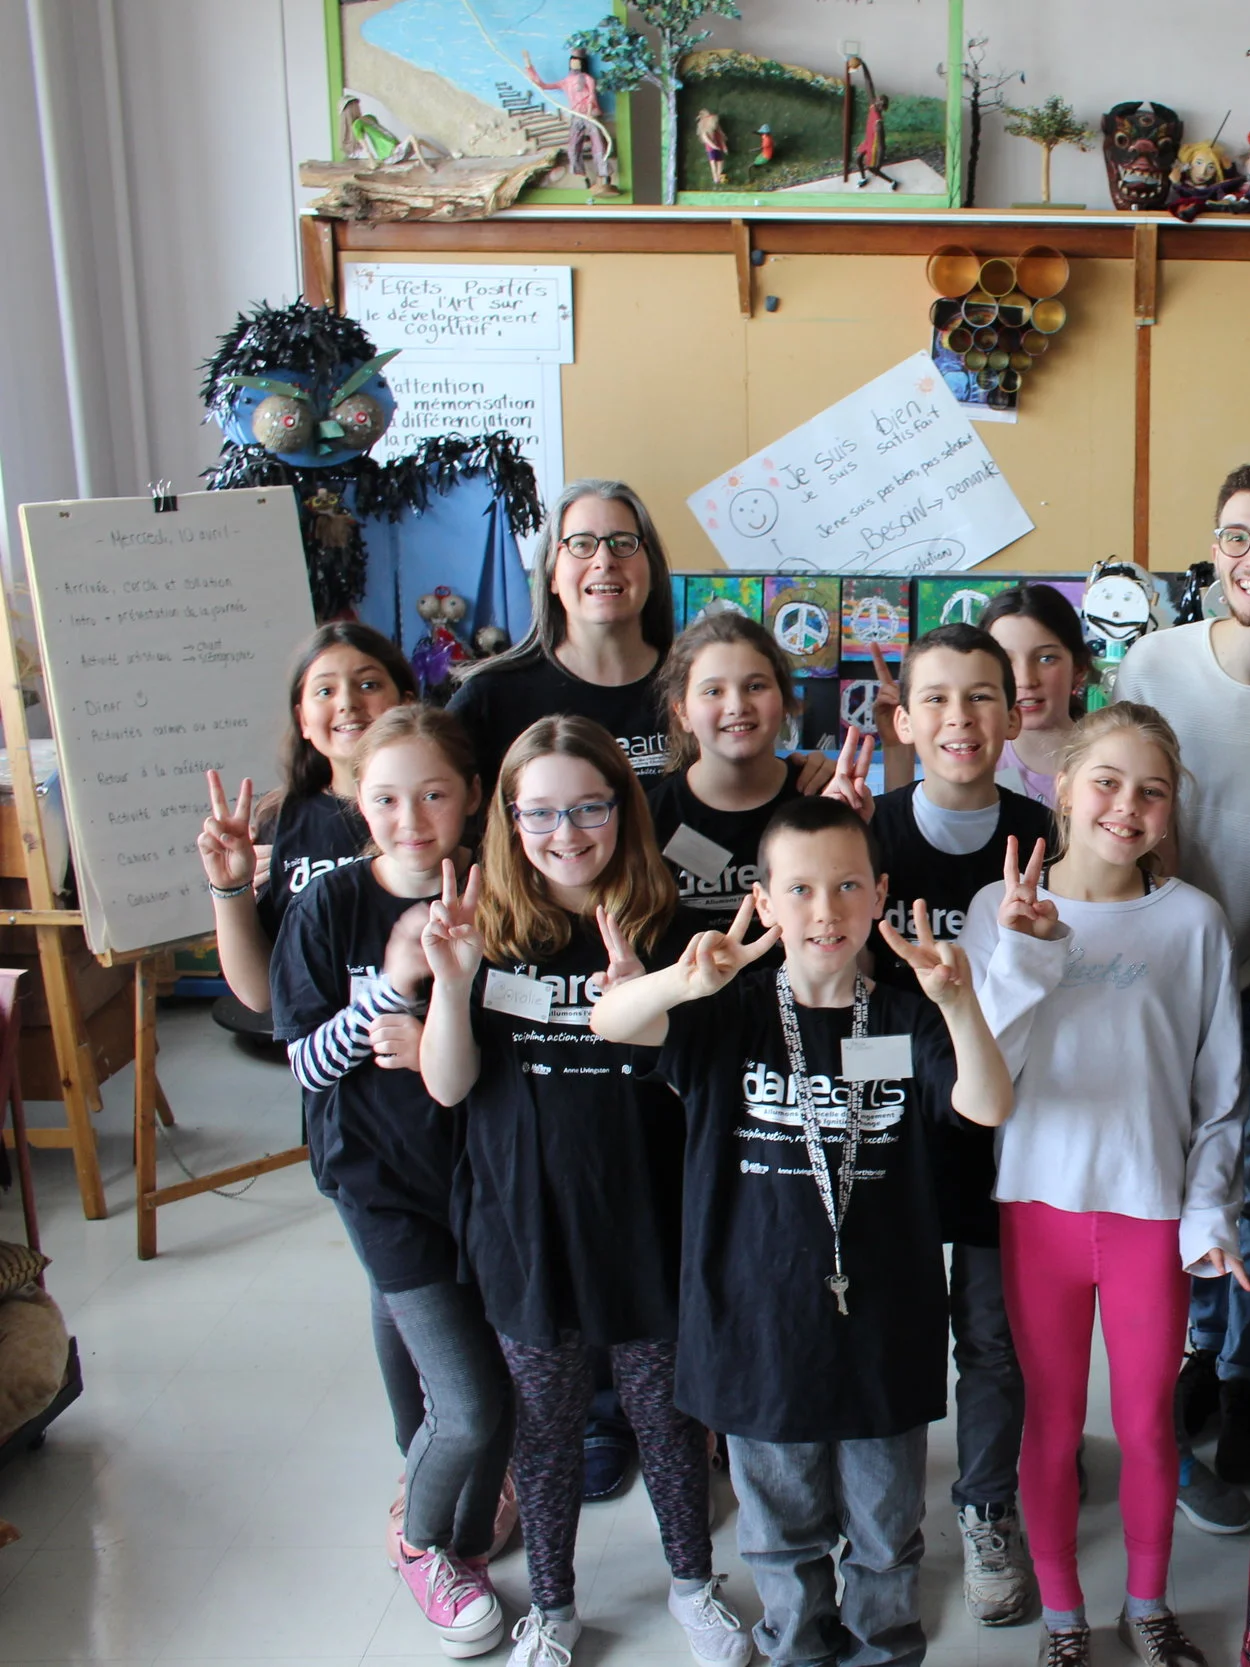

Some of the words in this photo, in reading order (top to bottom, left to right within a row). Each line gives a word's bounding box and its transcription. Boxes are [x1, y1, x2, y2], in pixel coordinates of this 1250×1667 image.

[381, 278, 442, 296] Effets
[465, 279, 547, 297] Positifs
[400, 296, 419, 309] de
[488, 299, 523, 310] sur
[367, 309, 381, 321] le
[387, 309, 538, 326] développement
[391, 377, 485, 395] 'attention
[414, 396, 535, 411] mémorisation
[779, 463, 810, 492] Je
[871, 400, 922, 437] bien
[828, 461, 859, 486] suis
[877, 405, 942, 456] satisfait
[876, 482, 896, 502] pas
[920, 458, 942, 476] pas
[178, 529, 194, 543] 10
[199, 525, 228, 540] avril
